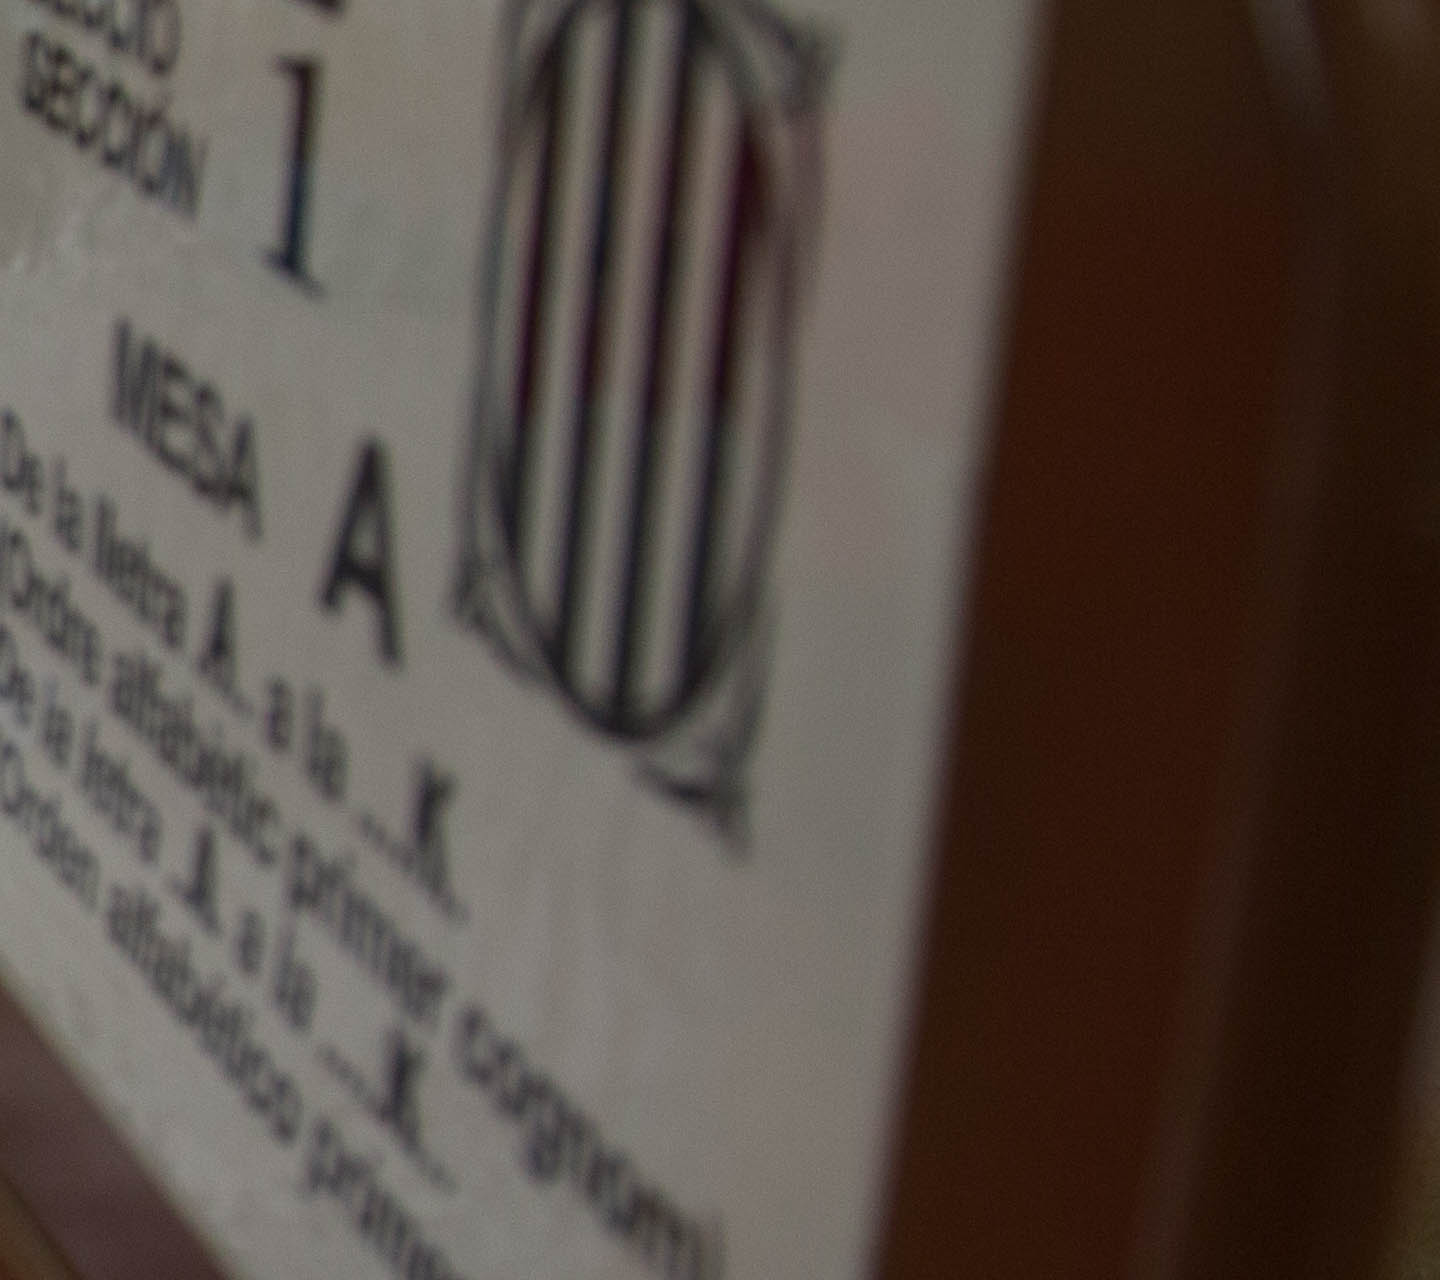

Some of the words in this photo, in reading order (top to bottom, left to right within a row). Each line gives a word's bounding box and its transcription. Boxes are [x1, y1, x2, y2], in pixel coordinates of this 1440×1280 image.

[264, 55, 327, 299] 1
[111, 315, 263, 546] MESA
[320, 432, 405, 670] A
[289, 830, 451, 1024] primer
